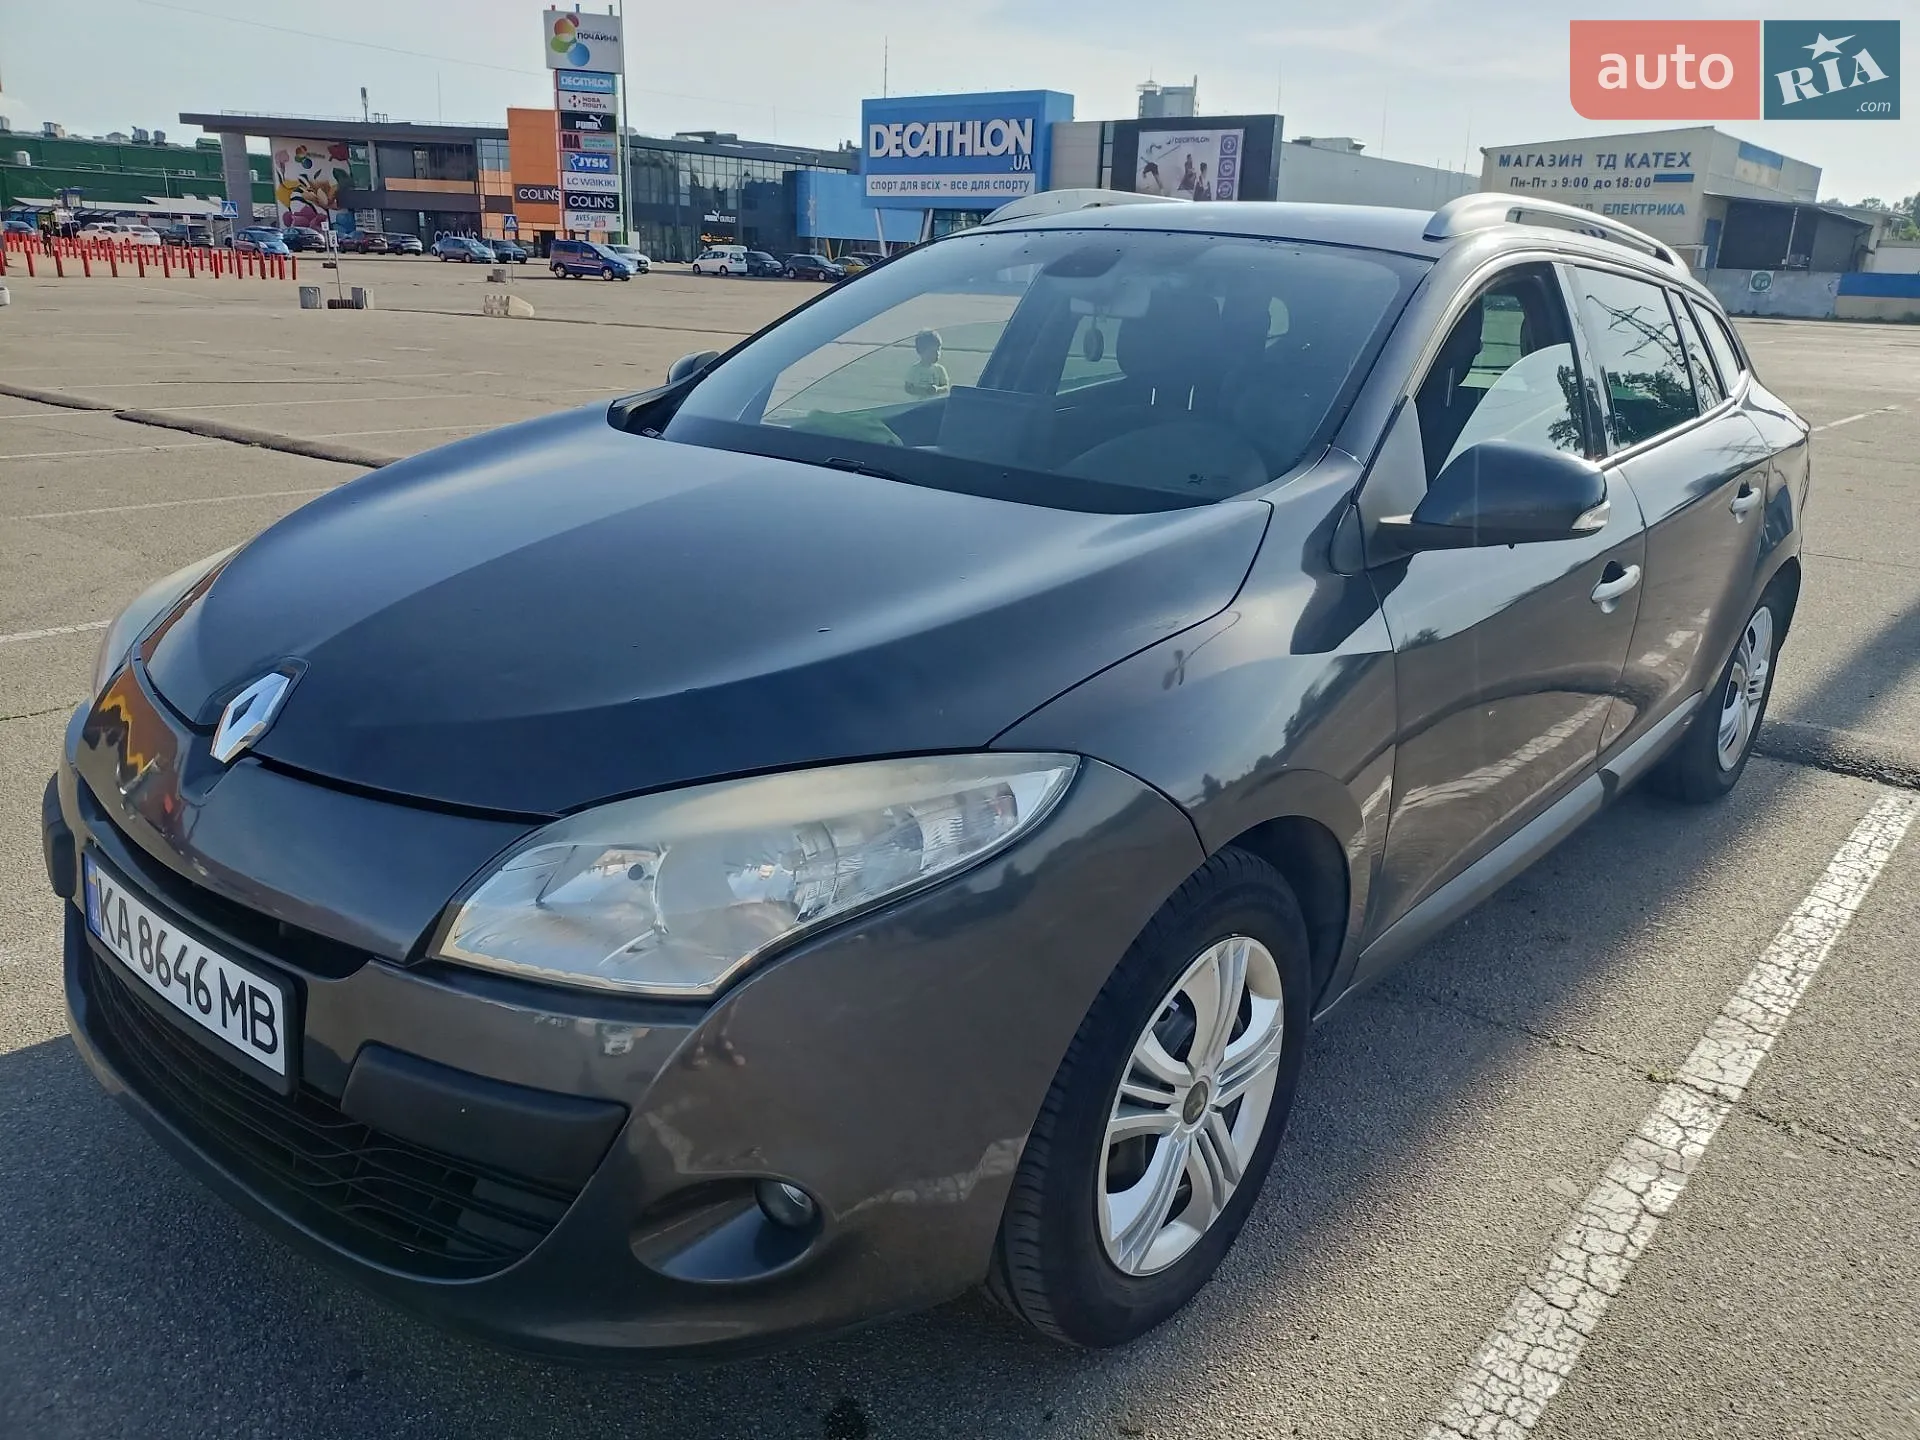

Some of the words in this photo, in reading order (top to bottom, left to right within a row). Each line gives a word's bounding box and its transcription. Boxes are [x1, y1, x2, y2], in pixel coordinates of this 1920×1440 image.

[577, 32, 618, 42] ПОЧАЙНА
[561, 76, 612, 88] DECATHLON
[869, 118, 1033, 157] DECATHLON
[578, 158, 608, 168] JYSK
[1010, 155, 1031, 170] .UA
[1499, 154, 1583, 168] МАГАЗИН
[1596, 153, 1617, 170] ТД
[1624, 152, 1691, 168] КАТЕХ
[567, 177, 578, 185] LC
[870, 180, 898, 192] спорт
[900, 181, 918, 192] для
[921, 179, 941, 190] всіх
[951, 180, 968, 190] все
[971, 180, 990, 191] для
[993, 179, 1030, 192] спорту
[1510, 177, 1547, 188] Пн-Пт
[1561, 177, 1588, 188] 9:00
[1593, 178, 1611, 190] до
[1616, 177, 1651, 188] 18:00
[519, 188, 560, 200] COLIN'S
[570, 196, 614, 208] COLIN'S
[1602, 203, 1686, 215] ЕЛЕКТРИКА
